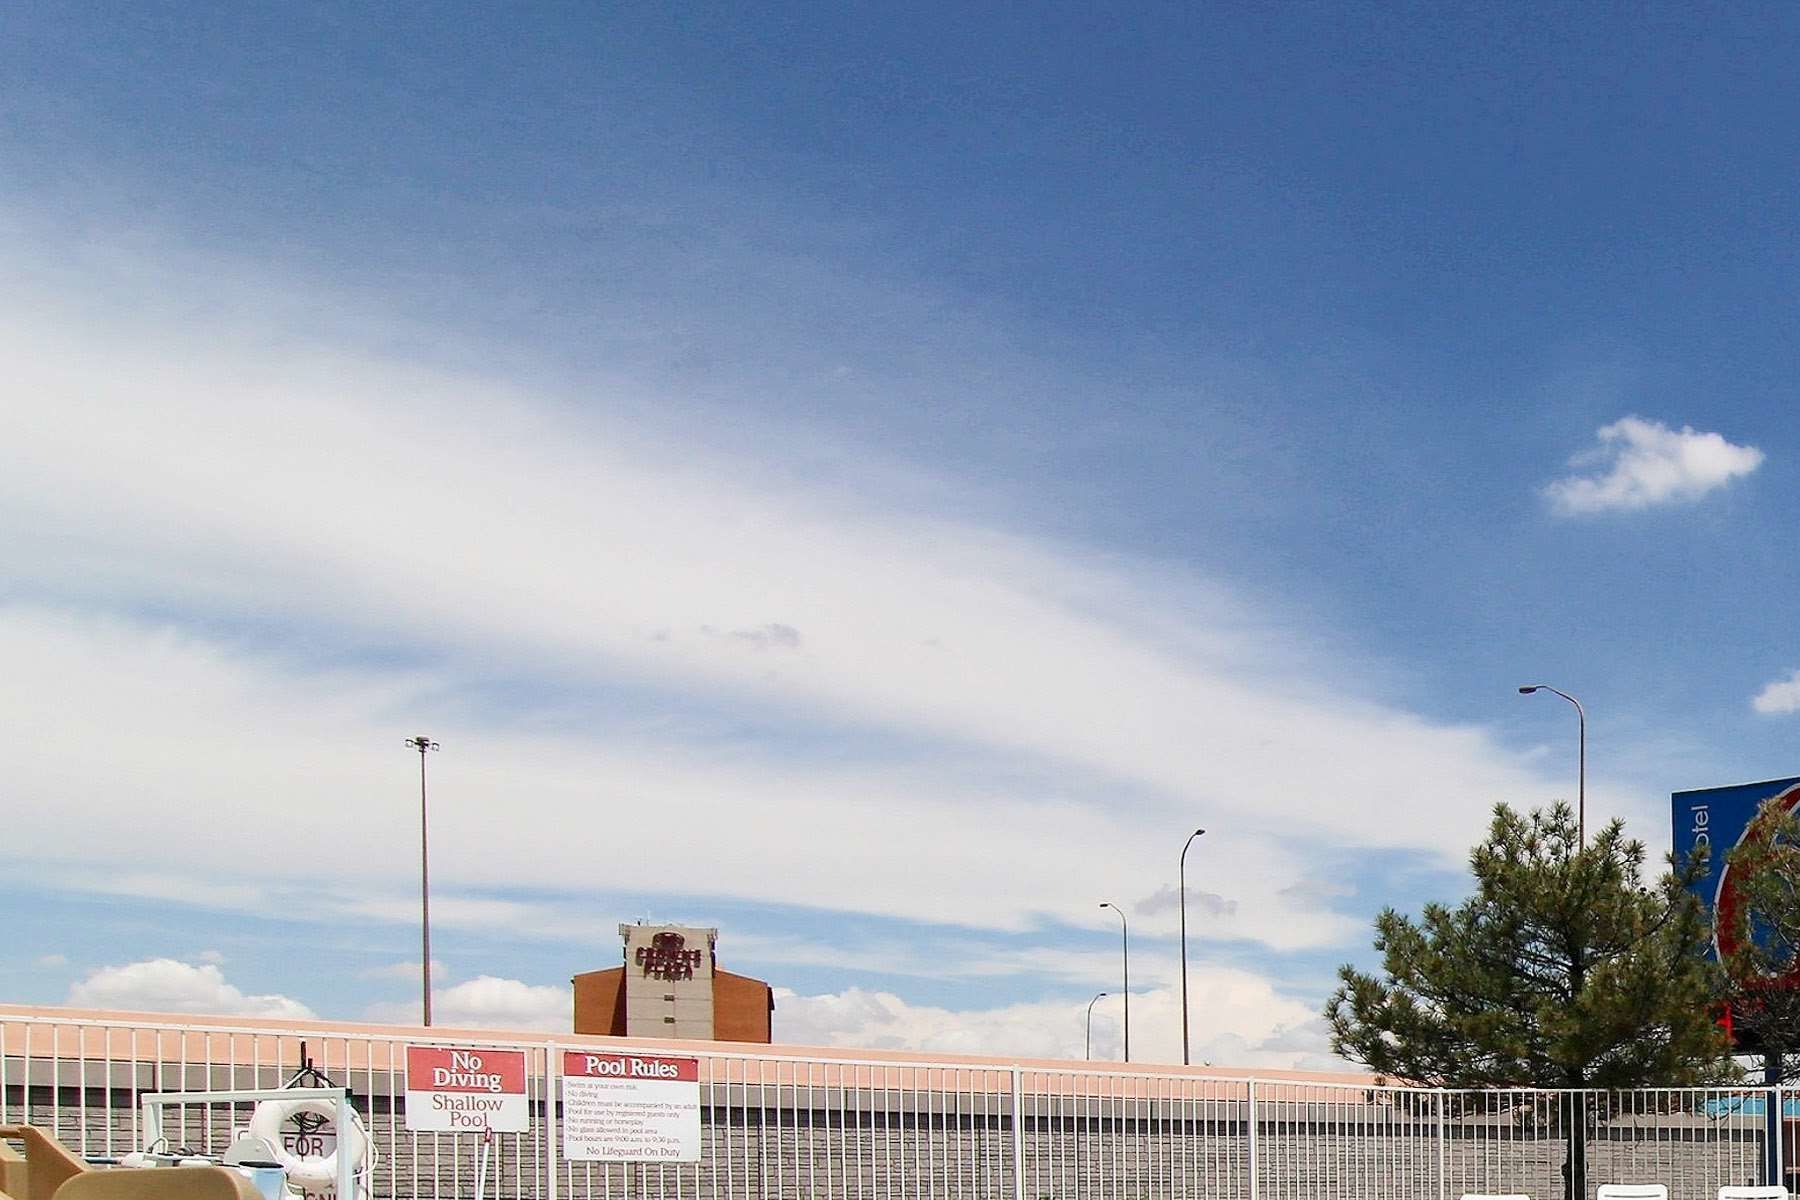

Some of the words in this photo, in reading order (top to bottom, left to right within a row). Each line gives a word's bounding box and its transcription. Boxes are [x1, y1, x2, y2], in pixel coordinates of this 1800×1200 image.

[450, 1051, 482, 1070] No
[585, 1055, 627, 1075] Pool
[630, 1058, 679, 1077] Rules
[433, 1067, 502, 1092] Diving
[432, 1094, 503, 1112] Shallow
[449, 1111, 488, 1127] Pool
[284, 1137, 323, 1156] FOR
[586, 1147, 600, 1155] No
[603, 1147, 642, 1157] Lifeguard
[644, 1147, 658, 1156] On
[660, 1148, 680, 1158] Duty
